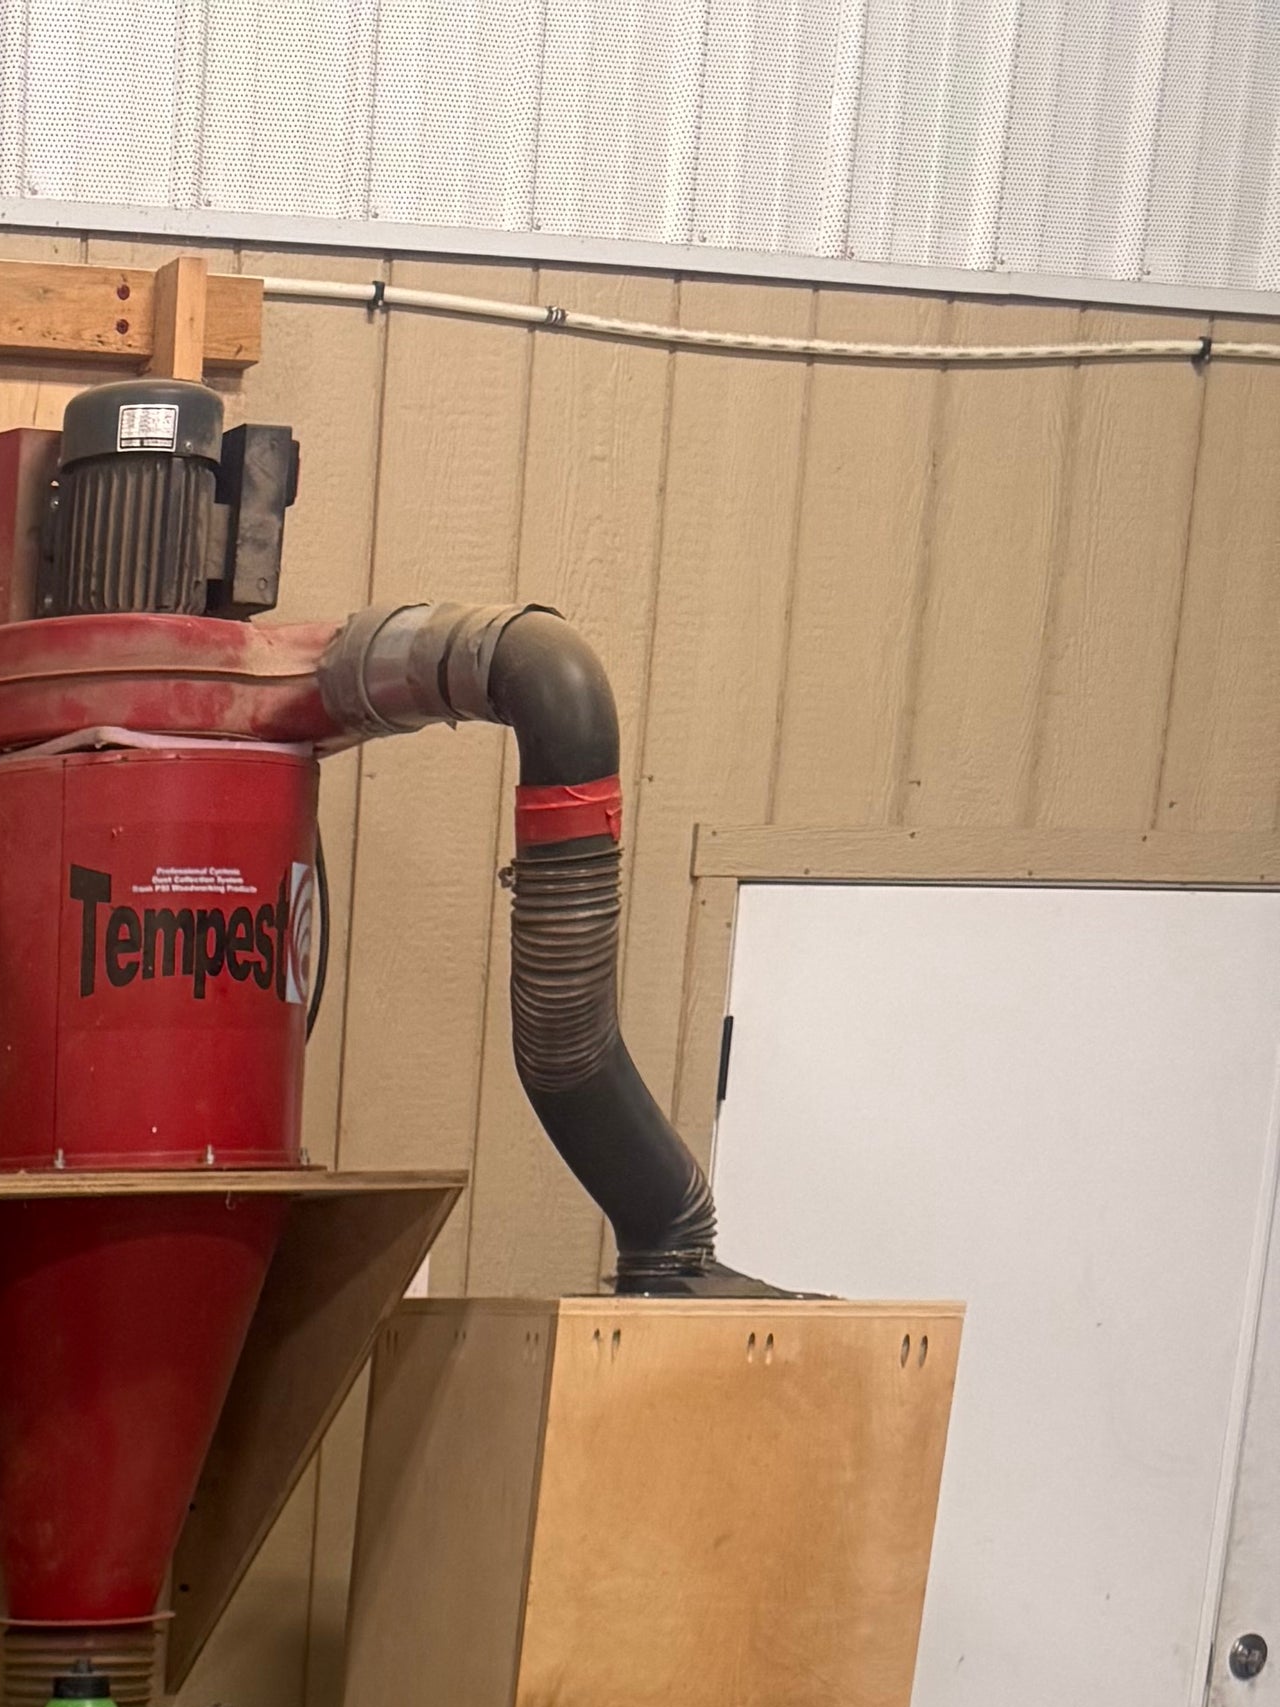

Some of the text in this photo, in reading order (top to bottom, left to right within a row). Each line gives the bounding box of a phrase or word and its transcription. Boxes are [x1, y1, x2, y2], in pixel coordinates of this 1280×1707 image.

[216, 876, 244, 885] System
[171, 885, 226, 894] Woodworking
[226, 885, 258, 894] Products
[70, 863, 291, 1002] Tempest
